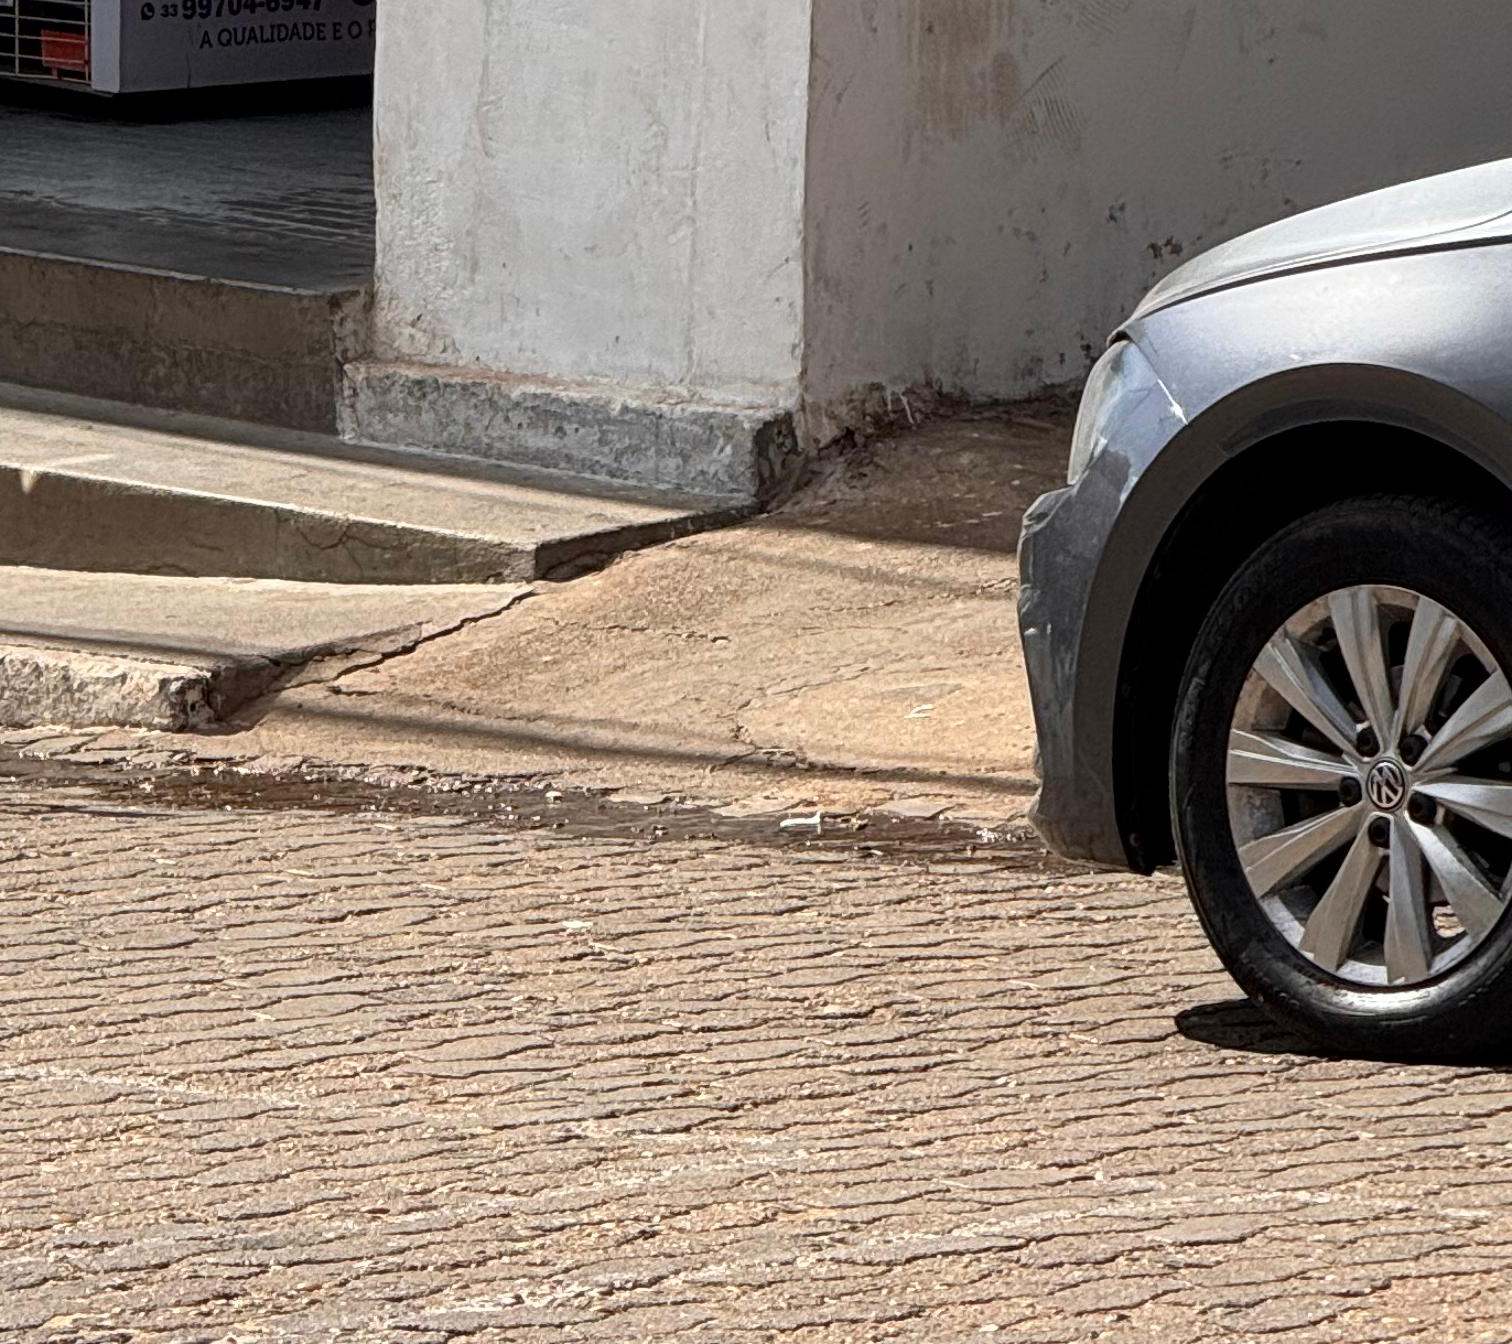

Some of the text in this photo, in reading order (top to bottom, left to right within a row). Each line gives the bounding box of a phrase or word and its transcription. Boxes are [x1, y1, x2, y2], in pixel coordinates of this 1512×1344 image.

[160, 3, 178, 18] 33
[199, 29, 213, 49] A
[217, 21, 326, 47] QUALIDADE
[332, 21, 343, 40] E
[347, 19, 363, 39] O
